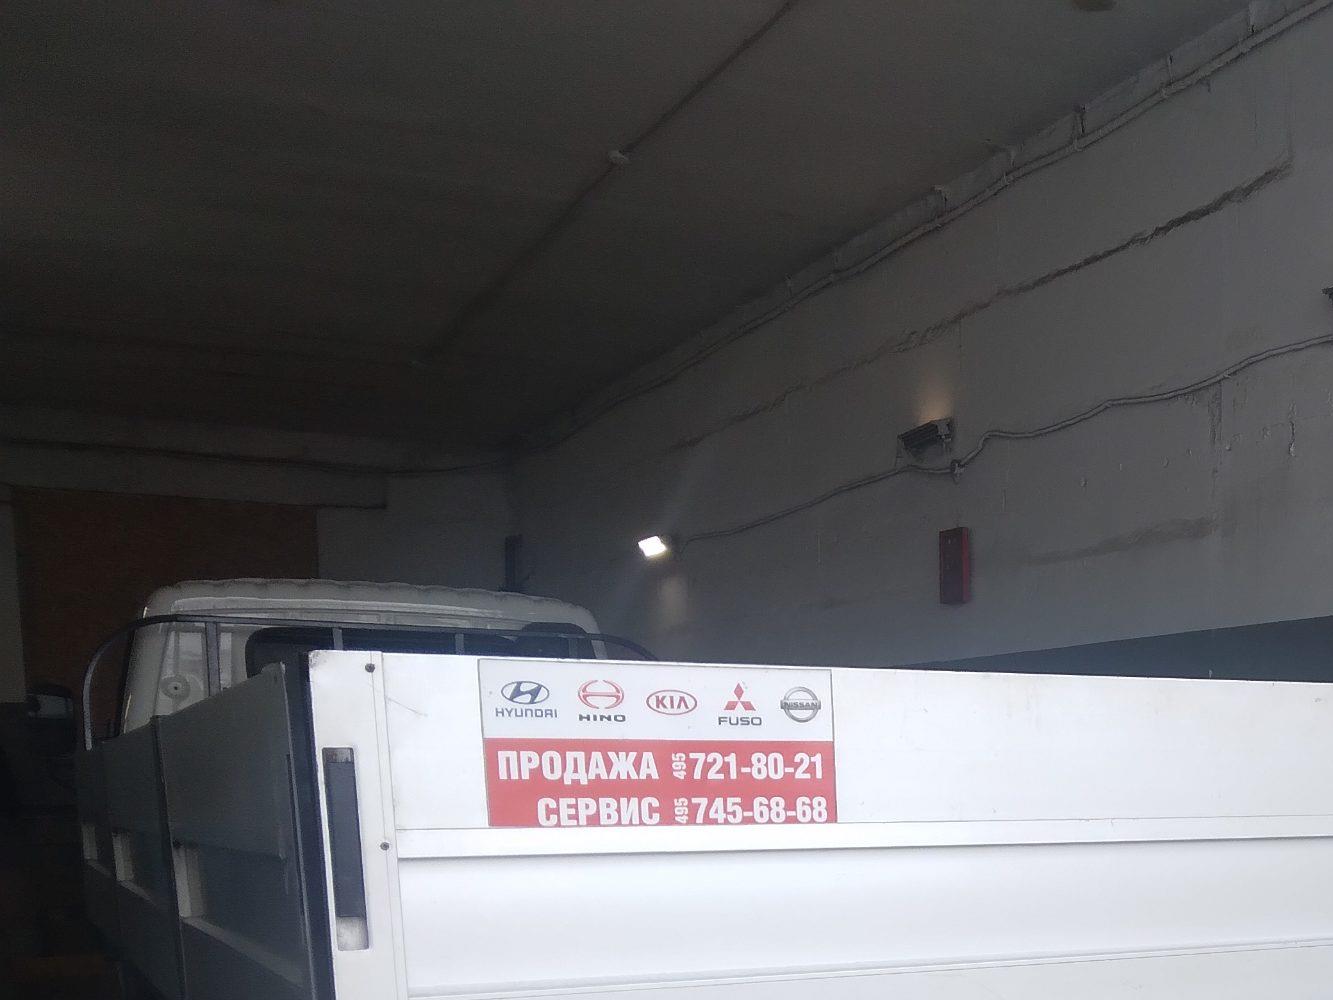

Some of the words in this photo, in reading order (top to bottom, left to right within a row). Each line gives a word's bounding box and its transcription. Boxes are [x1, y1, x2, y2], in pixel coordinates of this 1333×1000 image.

[655, 696, 691, 711] KIA
[783, 701, 820, 710] NISSAN
[494, 707, 559, 719] HYUNDAI
[578, 713, 627, 723] HINO
[718, 716, 763, 727] FUSO
[497, 750, 660, 785] ПРОДАЖА
[671, 752, 687, 780] 495
[688, 751, 824, 780] 721-80-21
[537, 797, 660, 827] СЕРВИС
[674, 797, 689, 824] 495
[691, 796, 828, 825] 745-68-68
